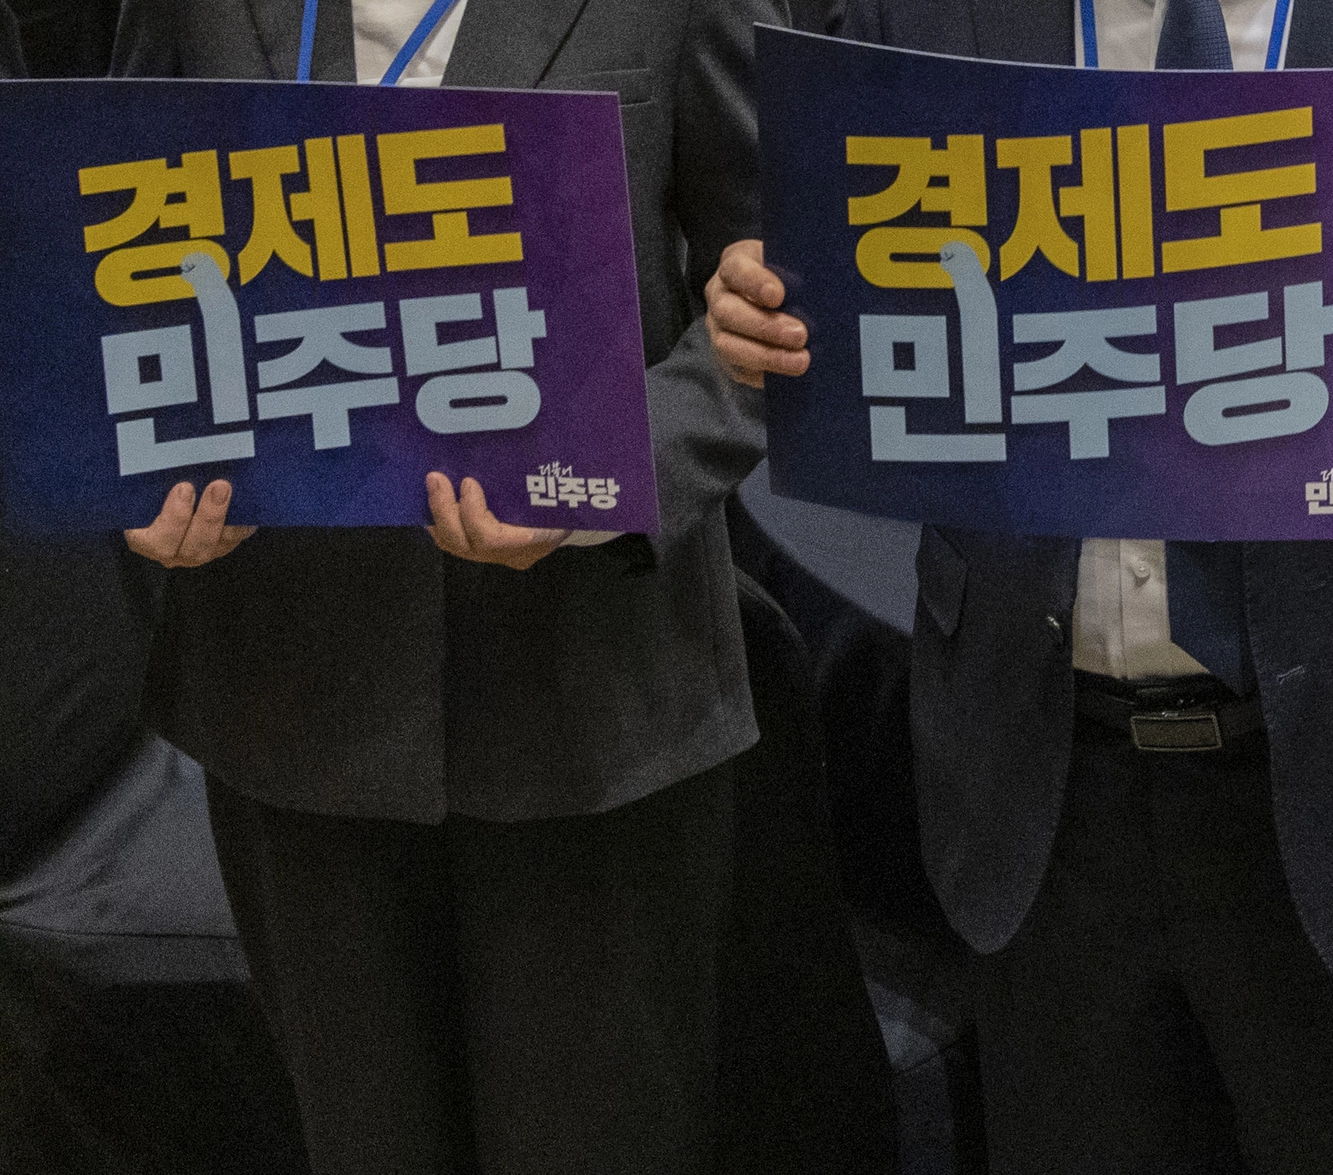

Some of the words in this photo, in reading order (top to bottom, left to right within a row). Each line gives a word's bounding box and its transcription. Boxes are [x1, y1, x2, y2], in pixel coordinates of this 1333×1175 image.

[78, 123, 524, 308] 경제도
[846, 106, 1323, 289] 경제도
[101, 252, 547, 477] 민주당
[526, 475, 620, 510] 민주당
[538, 460, 573, 478] 더불어
